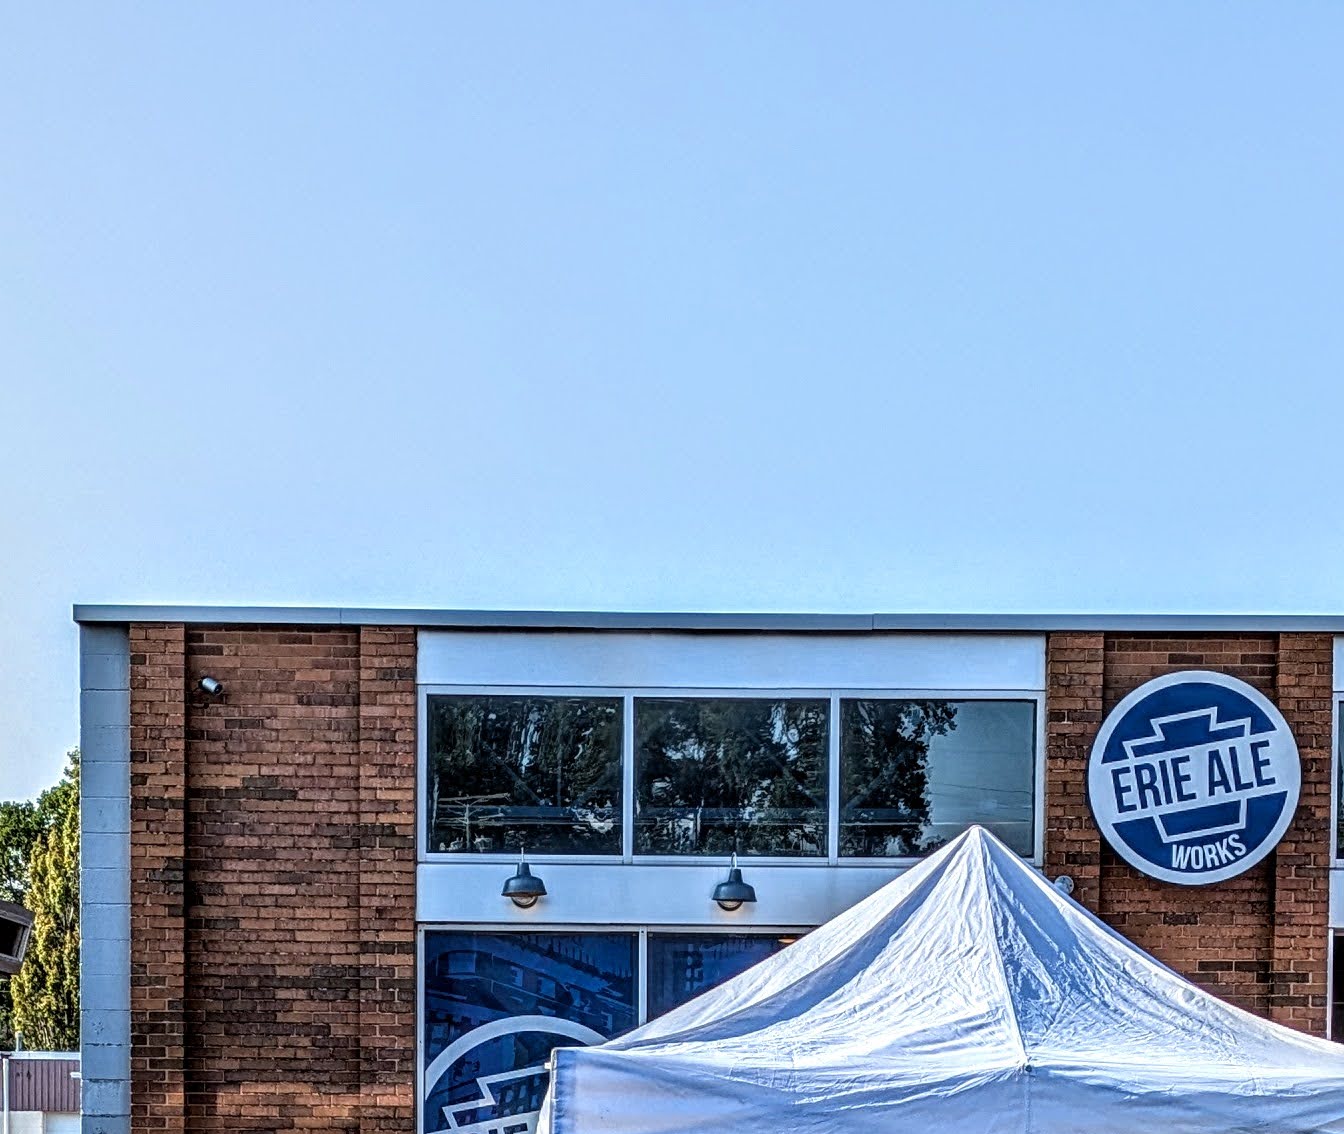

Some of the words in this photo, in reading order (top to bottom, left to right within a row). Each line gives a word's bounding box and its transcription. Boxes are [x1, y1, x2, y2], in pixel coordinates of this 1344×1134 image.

[1110, 755, 1197, 814] ERIE
[1208, 739, 1276, 797] ALE
[1171, 833, 1247, 870] WORKS
